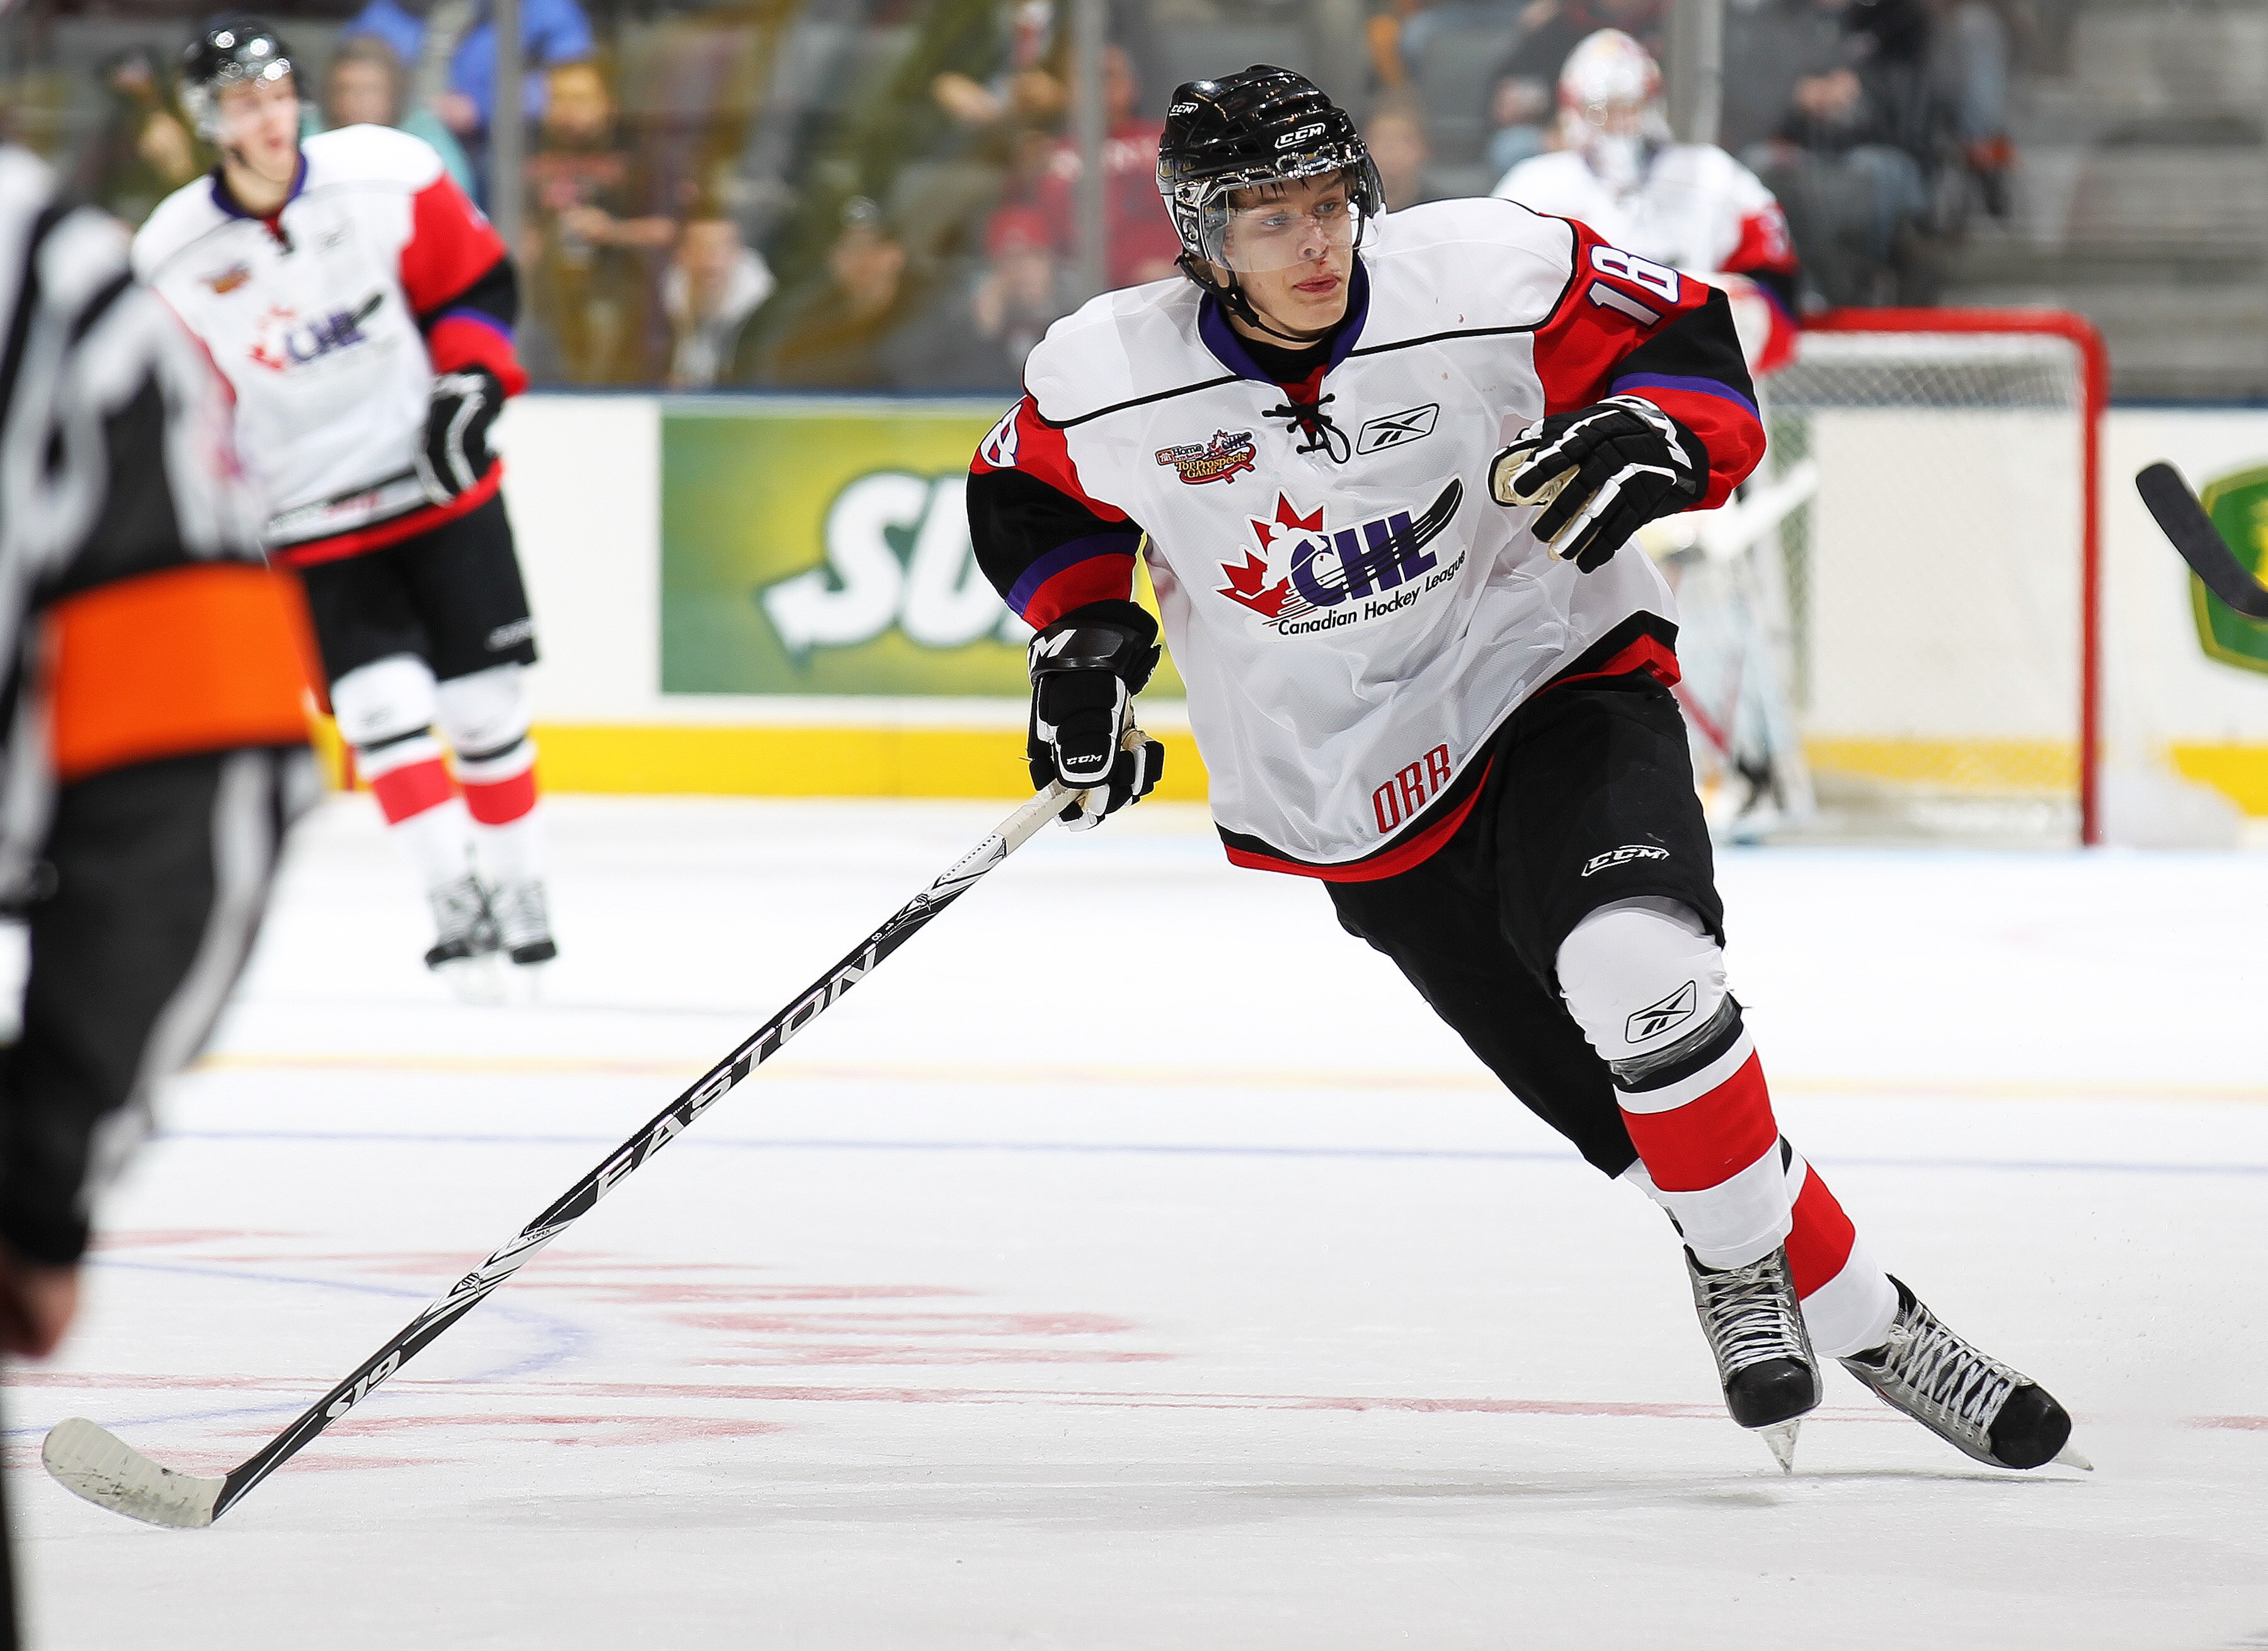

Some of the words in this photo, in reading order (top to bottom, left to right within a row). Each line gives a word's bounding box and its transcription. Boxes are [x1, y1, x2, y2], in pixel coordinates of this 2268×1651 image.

[1171, 103, 1196, 115] CCM
[1276, 124, 1324, 147] CCM
[1585, 243, 1680, 329] 18
[1187, 464, 1217, 478] GAME
[761, 470, 1036, 661] SU
[1278, 609, 1358, 636] Canadian
[1364, 586, 1421, 620] Hockey
[1425, 551, 1466, 593] League
[1290, 510, 1438, 607] CHL
[1066, 754, 1103, 765] CCM
[1372, 743, 1452, 834] ORR
[1584, 846, 1668, 873] CCM
[595, 942, 878, 1202] EASTON
[321, 1349, 401, 1431] S19
